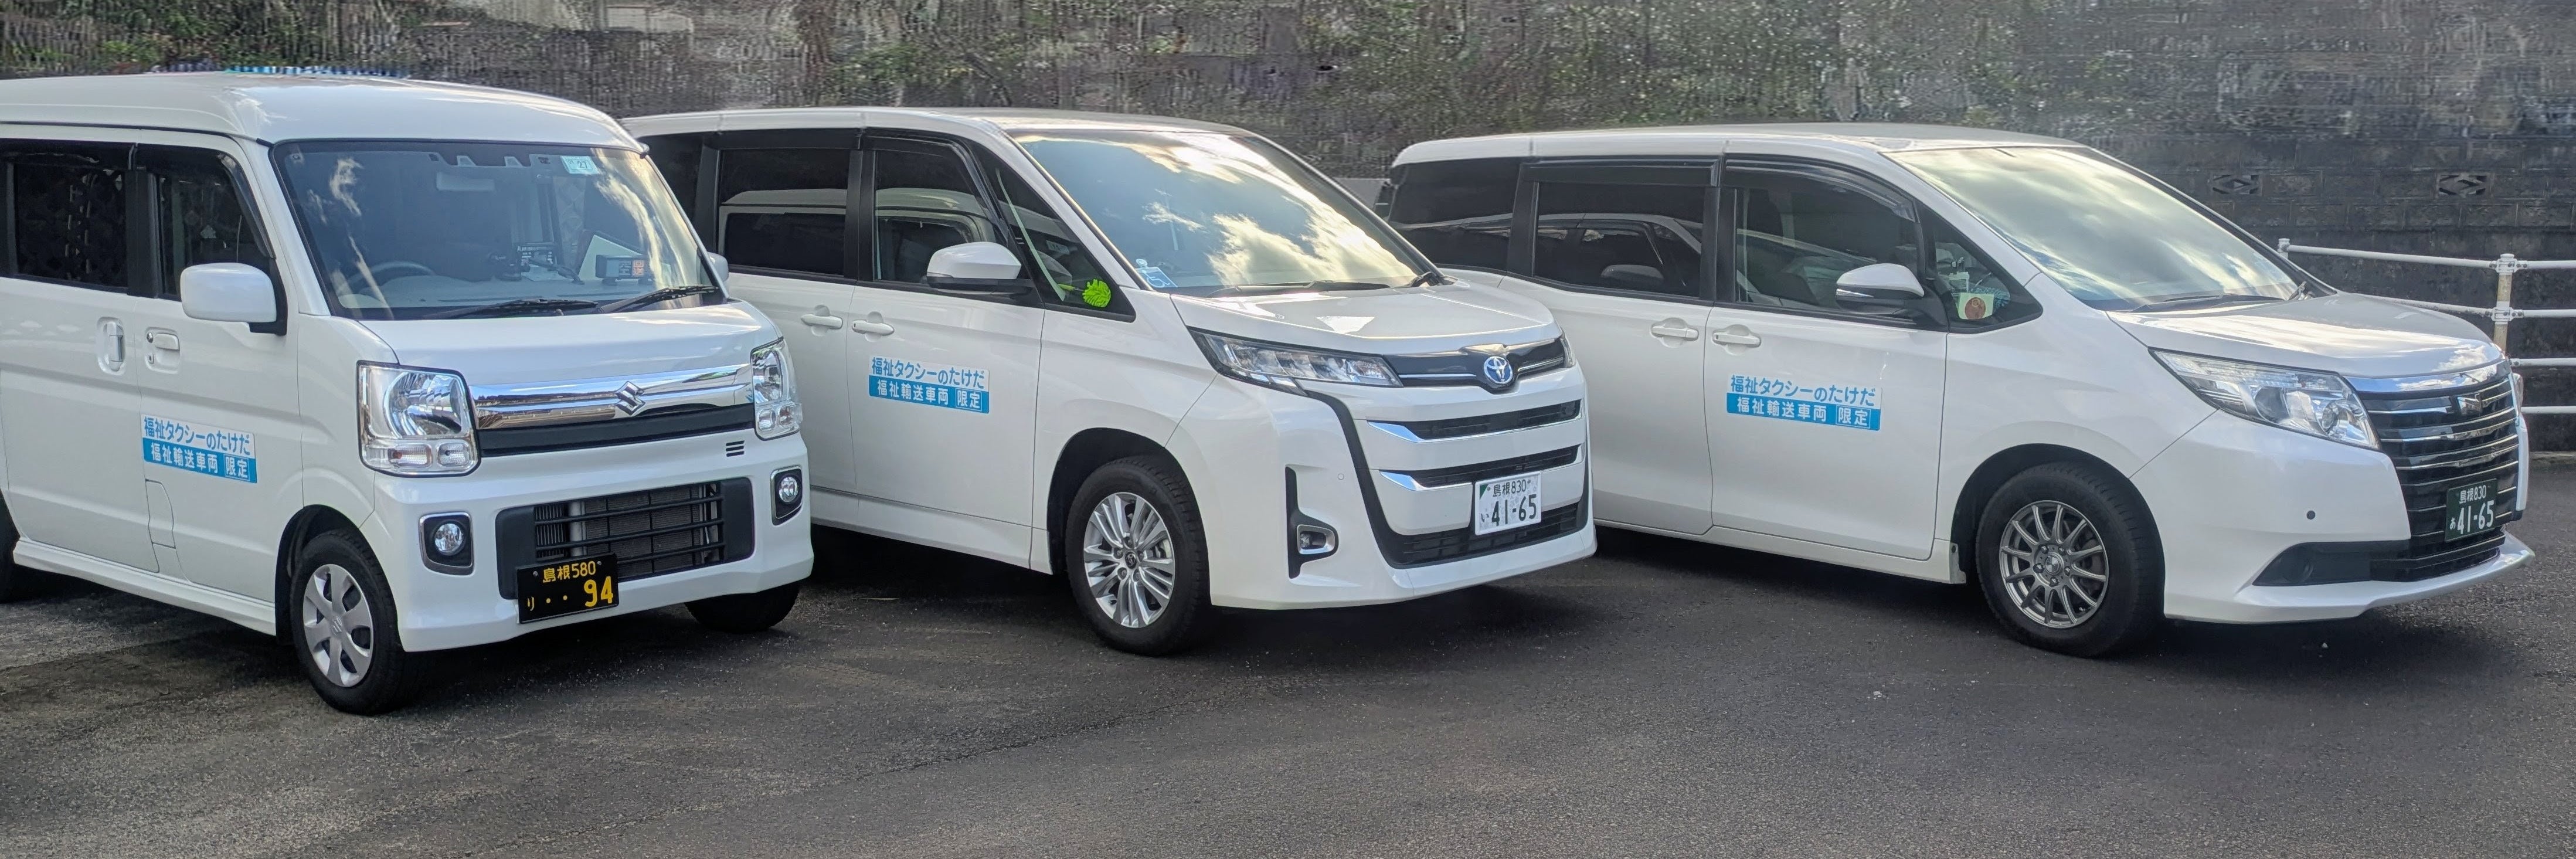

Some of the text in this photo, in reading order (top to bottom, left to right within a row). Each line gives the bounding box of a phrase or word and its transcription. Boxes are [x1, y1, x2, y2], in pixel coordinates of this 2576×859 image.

[872, 356, 985, 389] 福祉タクシーのたけだ
[878, 379, 980, 409] 福祉輸送車両 限定
[1731, 375, 1875, 406] 福祉タクシーのたけだ
[1737, 396, 1868, 426] 福祉輸送車両 限定
[144, 416, 250, 456] 福祉タクシーのたけだ
[151, 442, 248, 478] 福祉輸送車両 限定
[1480, 494, 1537, 526] い 41-65
[2457, 500, 2494, 534] 41-65
[528, 596, 535, 611] り
[583, 576, 614, 607] 94
